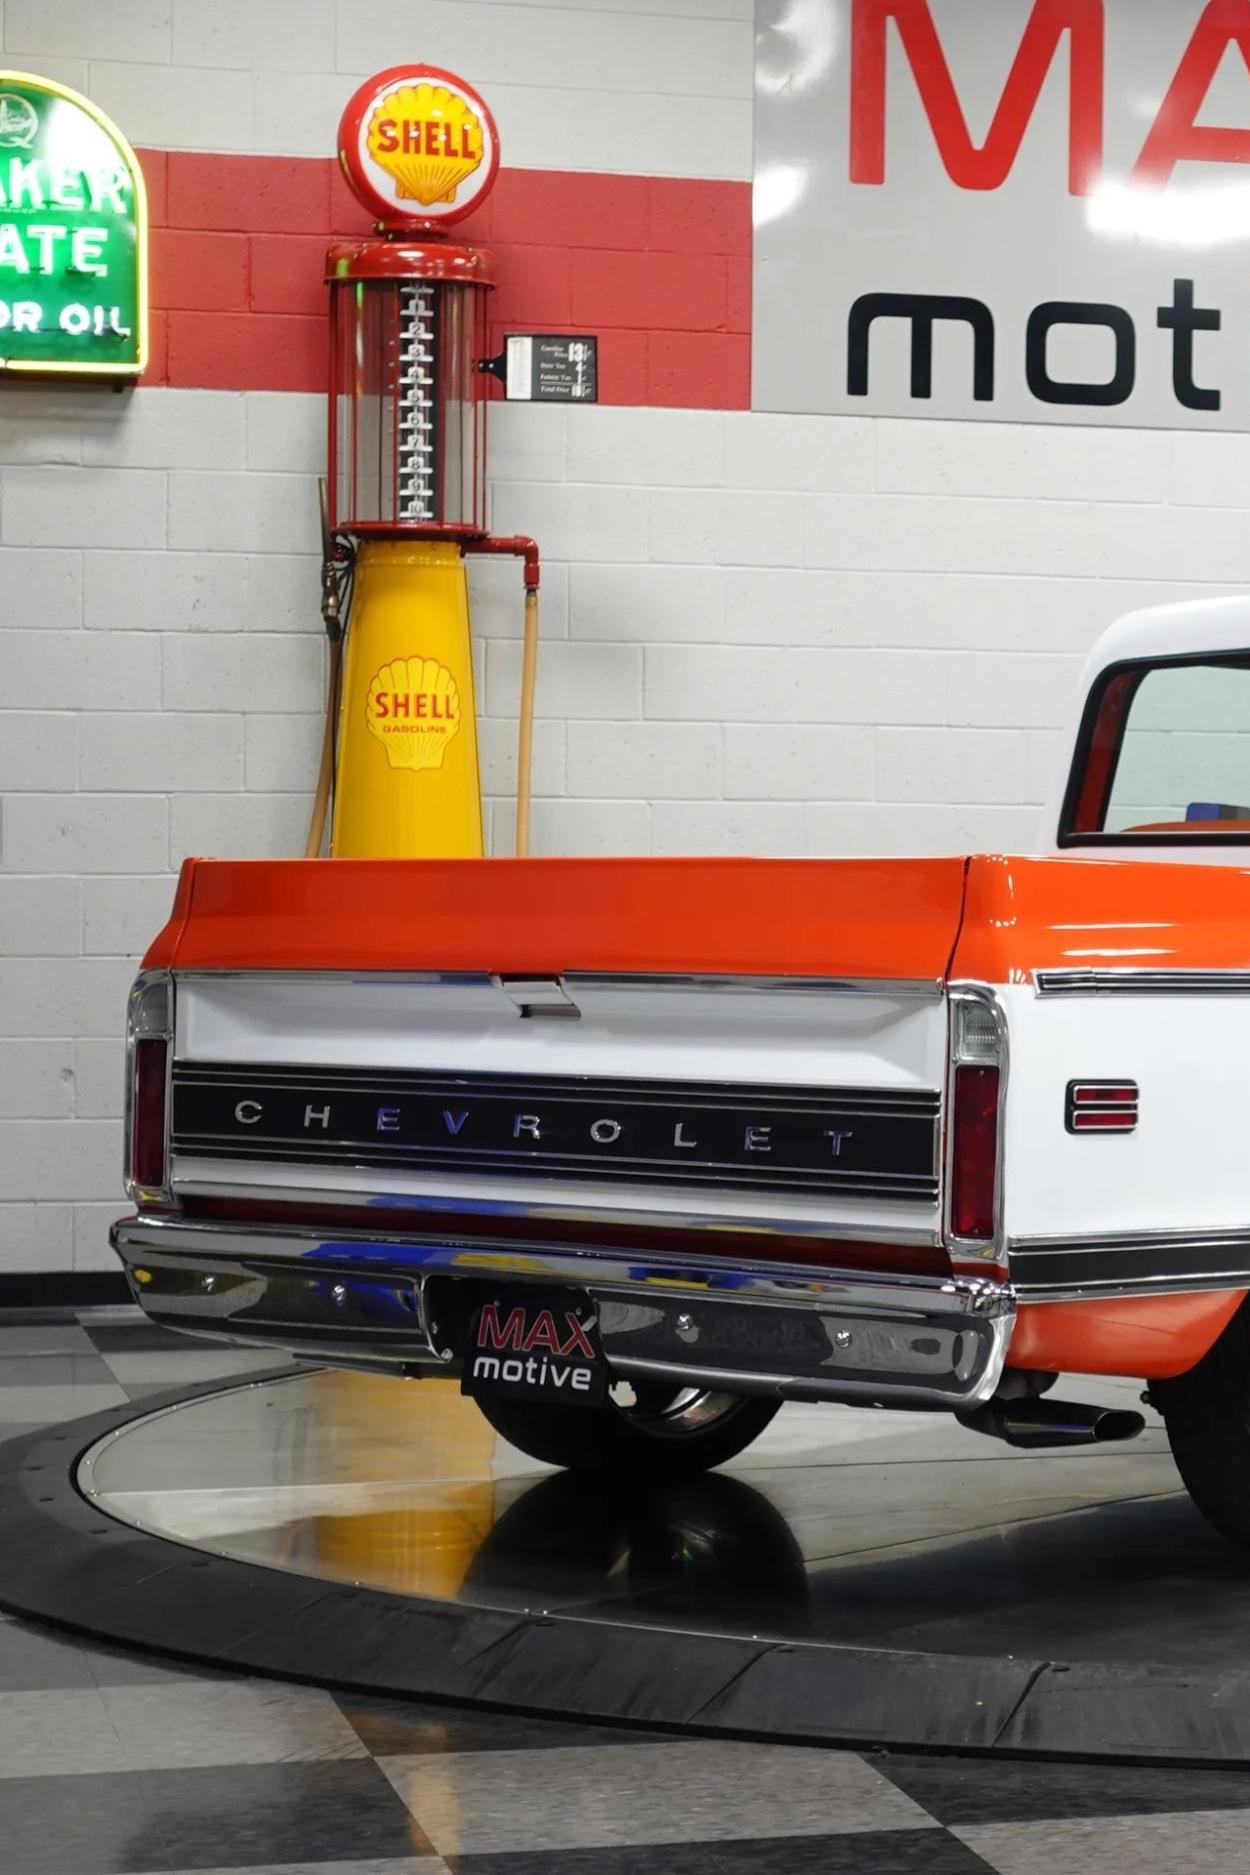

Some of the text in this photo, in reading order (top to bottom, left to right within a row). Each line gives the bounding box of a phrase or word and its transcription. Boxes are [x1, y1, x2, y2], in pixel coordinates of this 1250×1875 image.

[378, 119, 476, 159] SHELL
[0, 157, 128, 213] KER
[59, 303, 131, 337] OIL
[375, 692, 454, 719] SHELL
[383, 725, 446, 733] GASOLINE
[235, 1100, 853, 1156] CHEVROLET
[477, 1304, 597, 1359] MAX
[473, 1356, 592, 1391] motive
